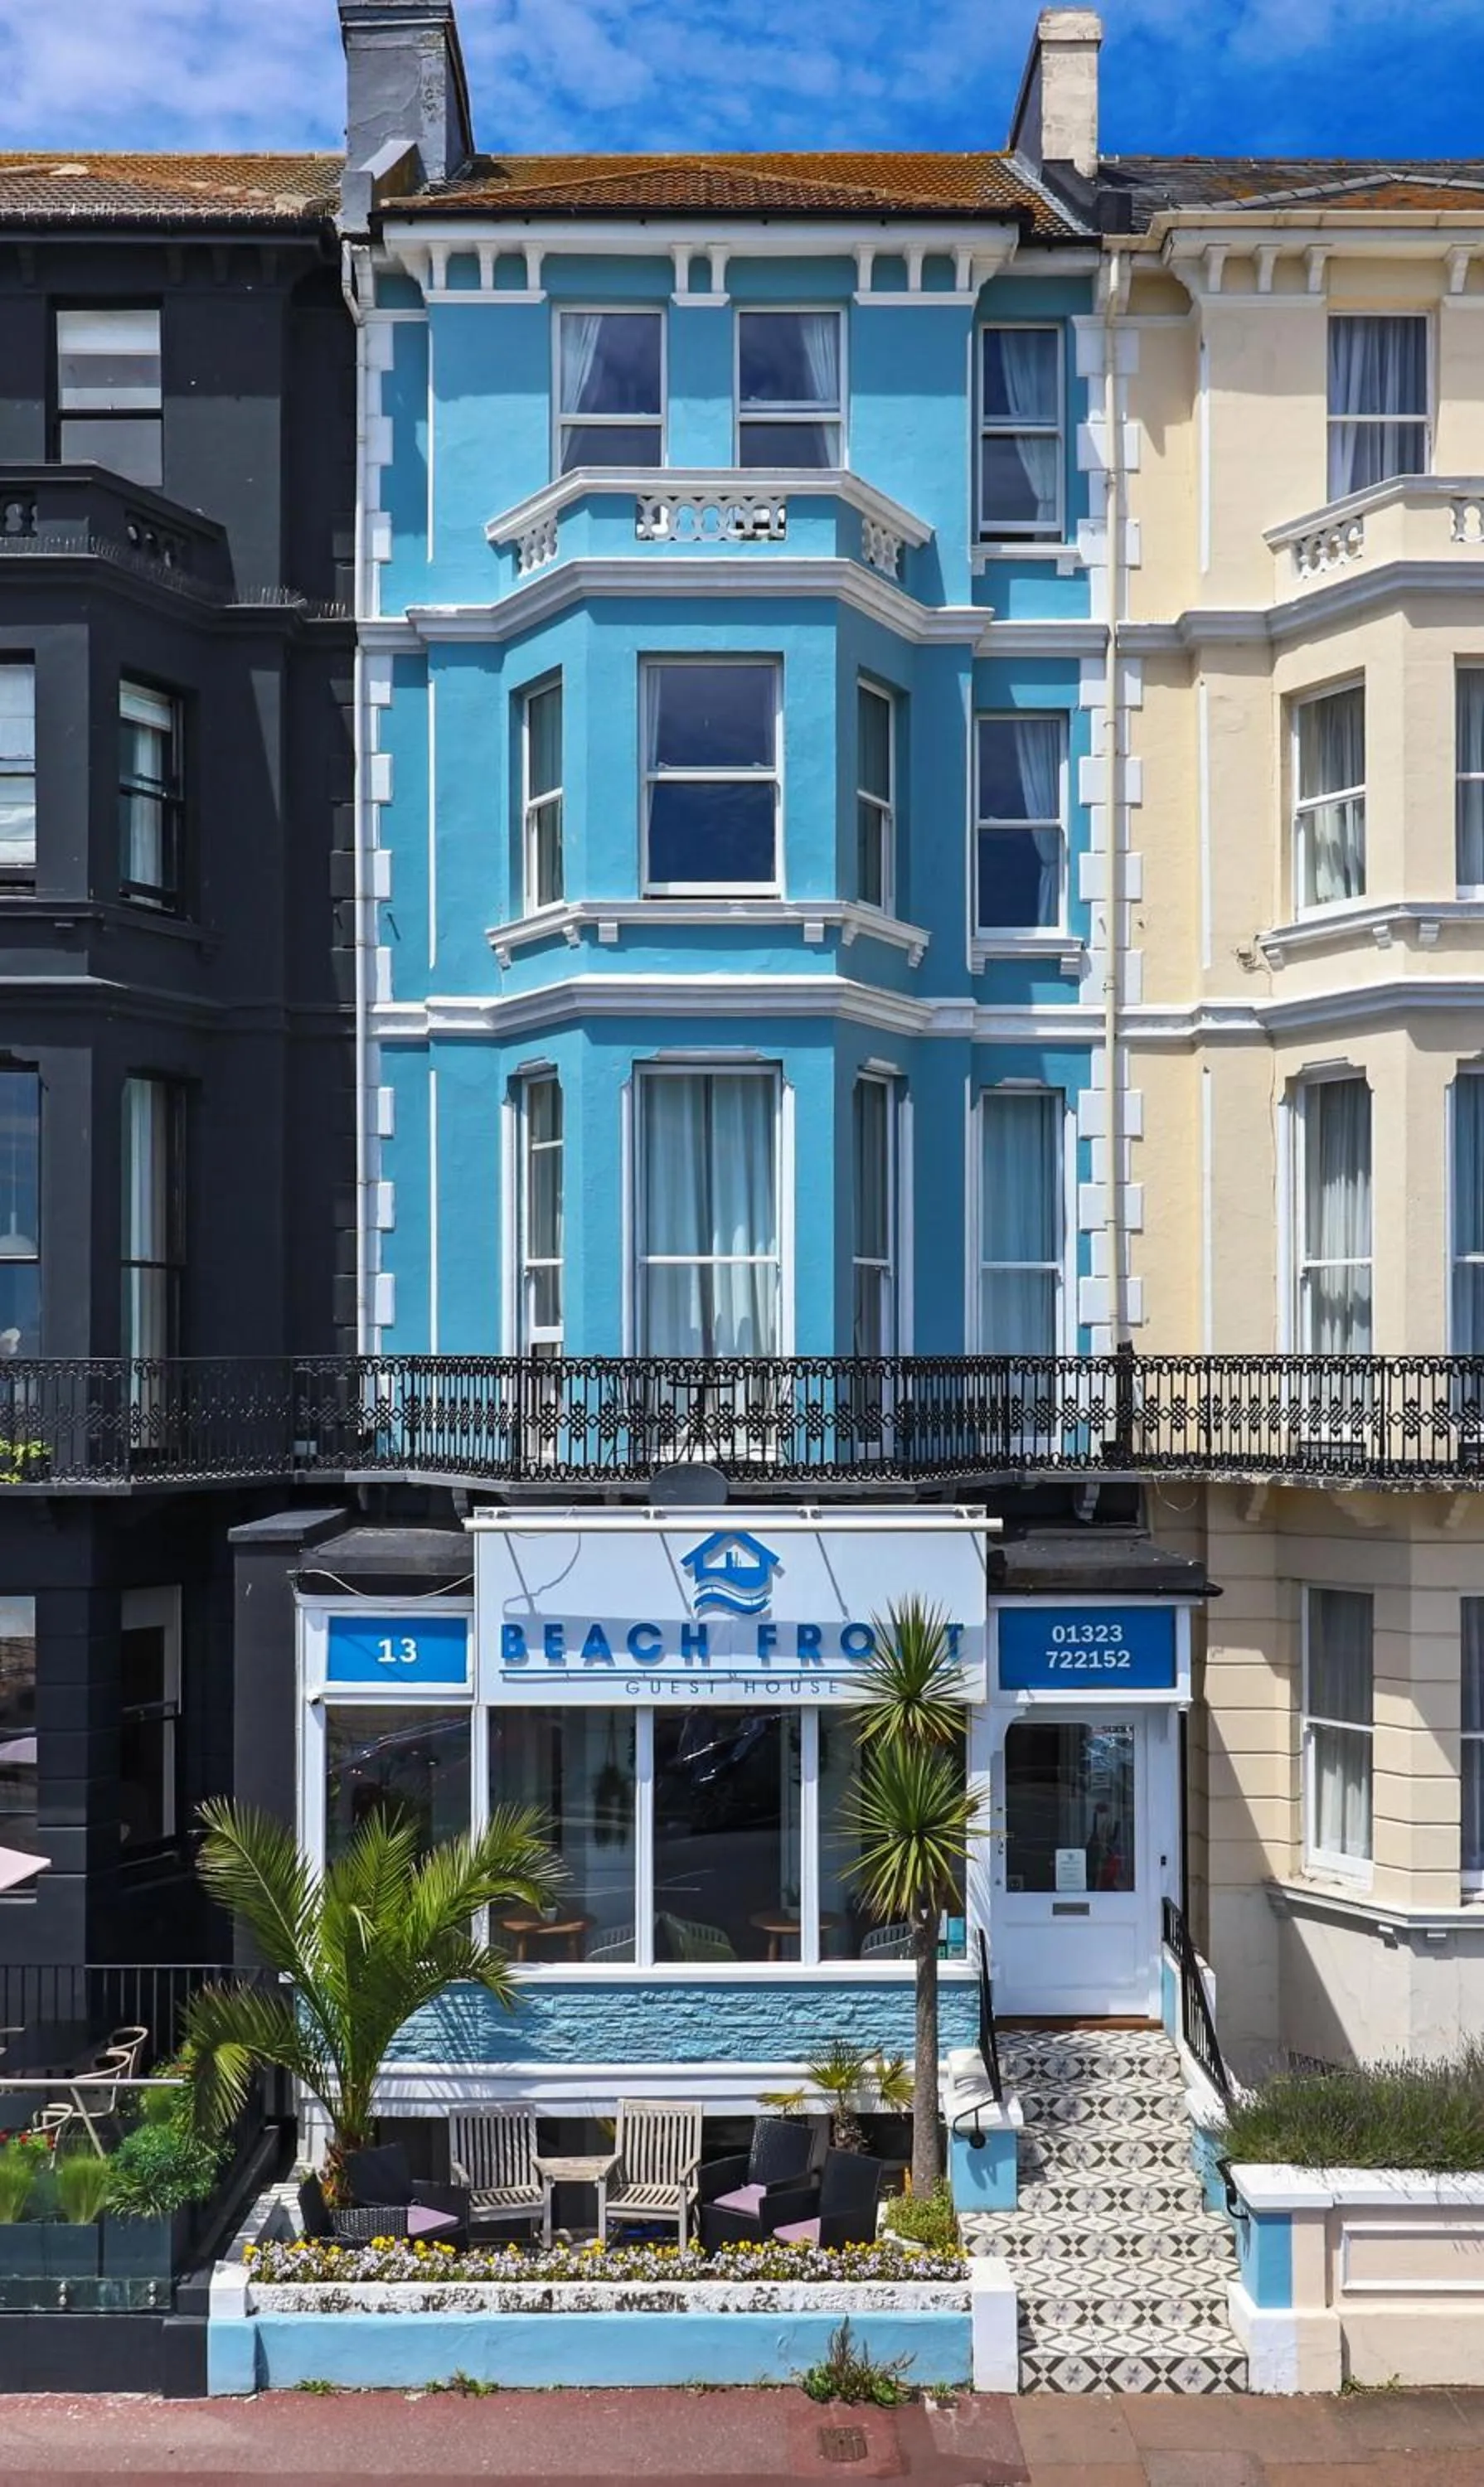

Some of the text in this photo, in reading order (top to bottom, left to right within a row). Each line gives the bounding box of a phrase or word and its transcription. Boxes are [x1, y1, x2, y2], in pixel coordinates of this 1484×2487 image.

[501, 1622, 964, 1660] BEACH FROT
[1052, 1625, 1123, 1643] 01323
[376, 1637, 417, 1663] 13
[1045, 1650, 1131, 1668] 722152
[626, 1680, 840, 1694] GUEST HOUSE
